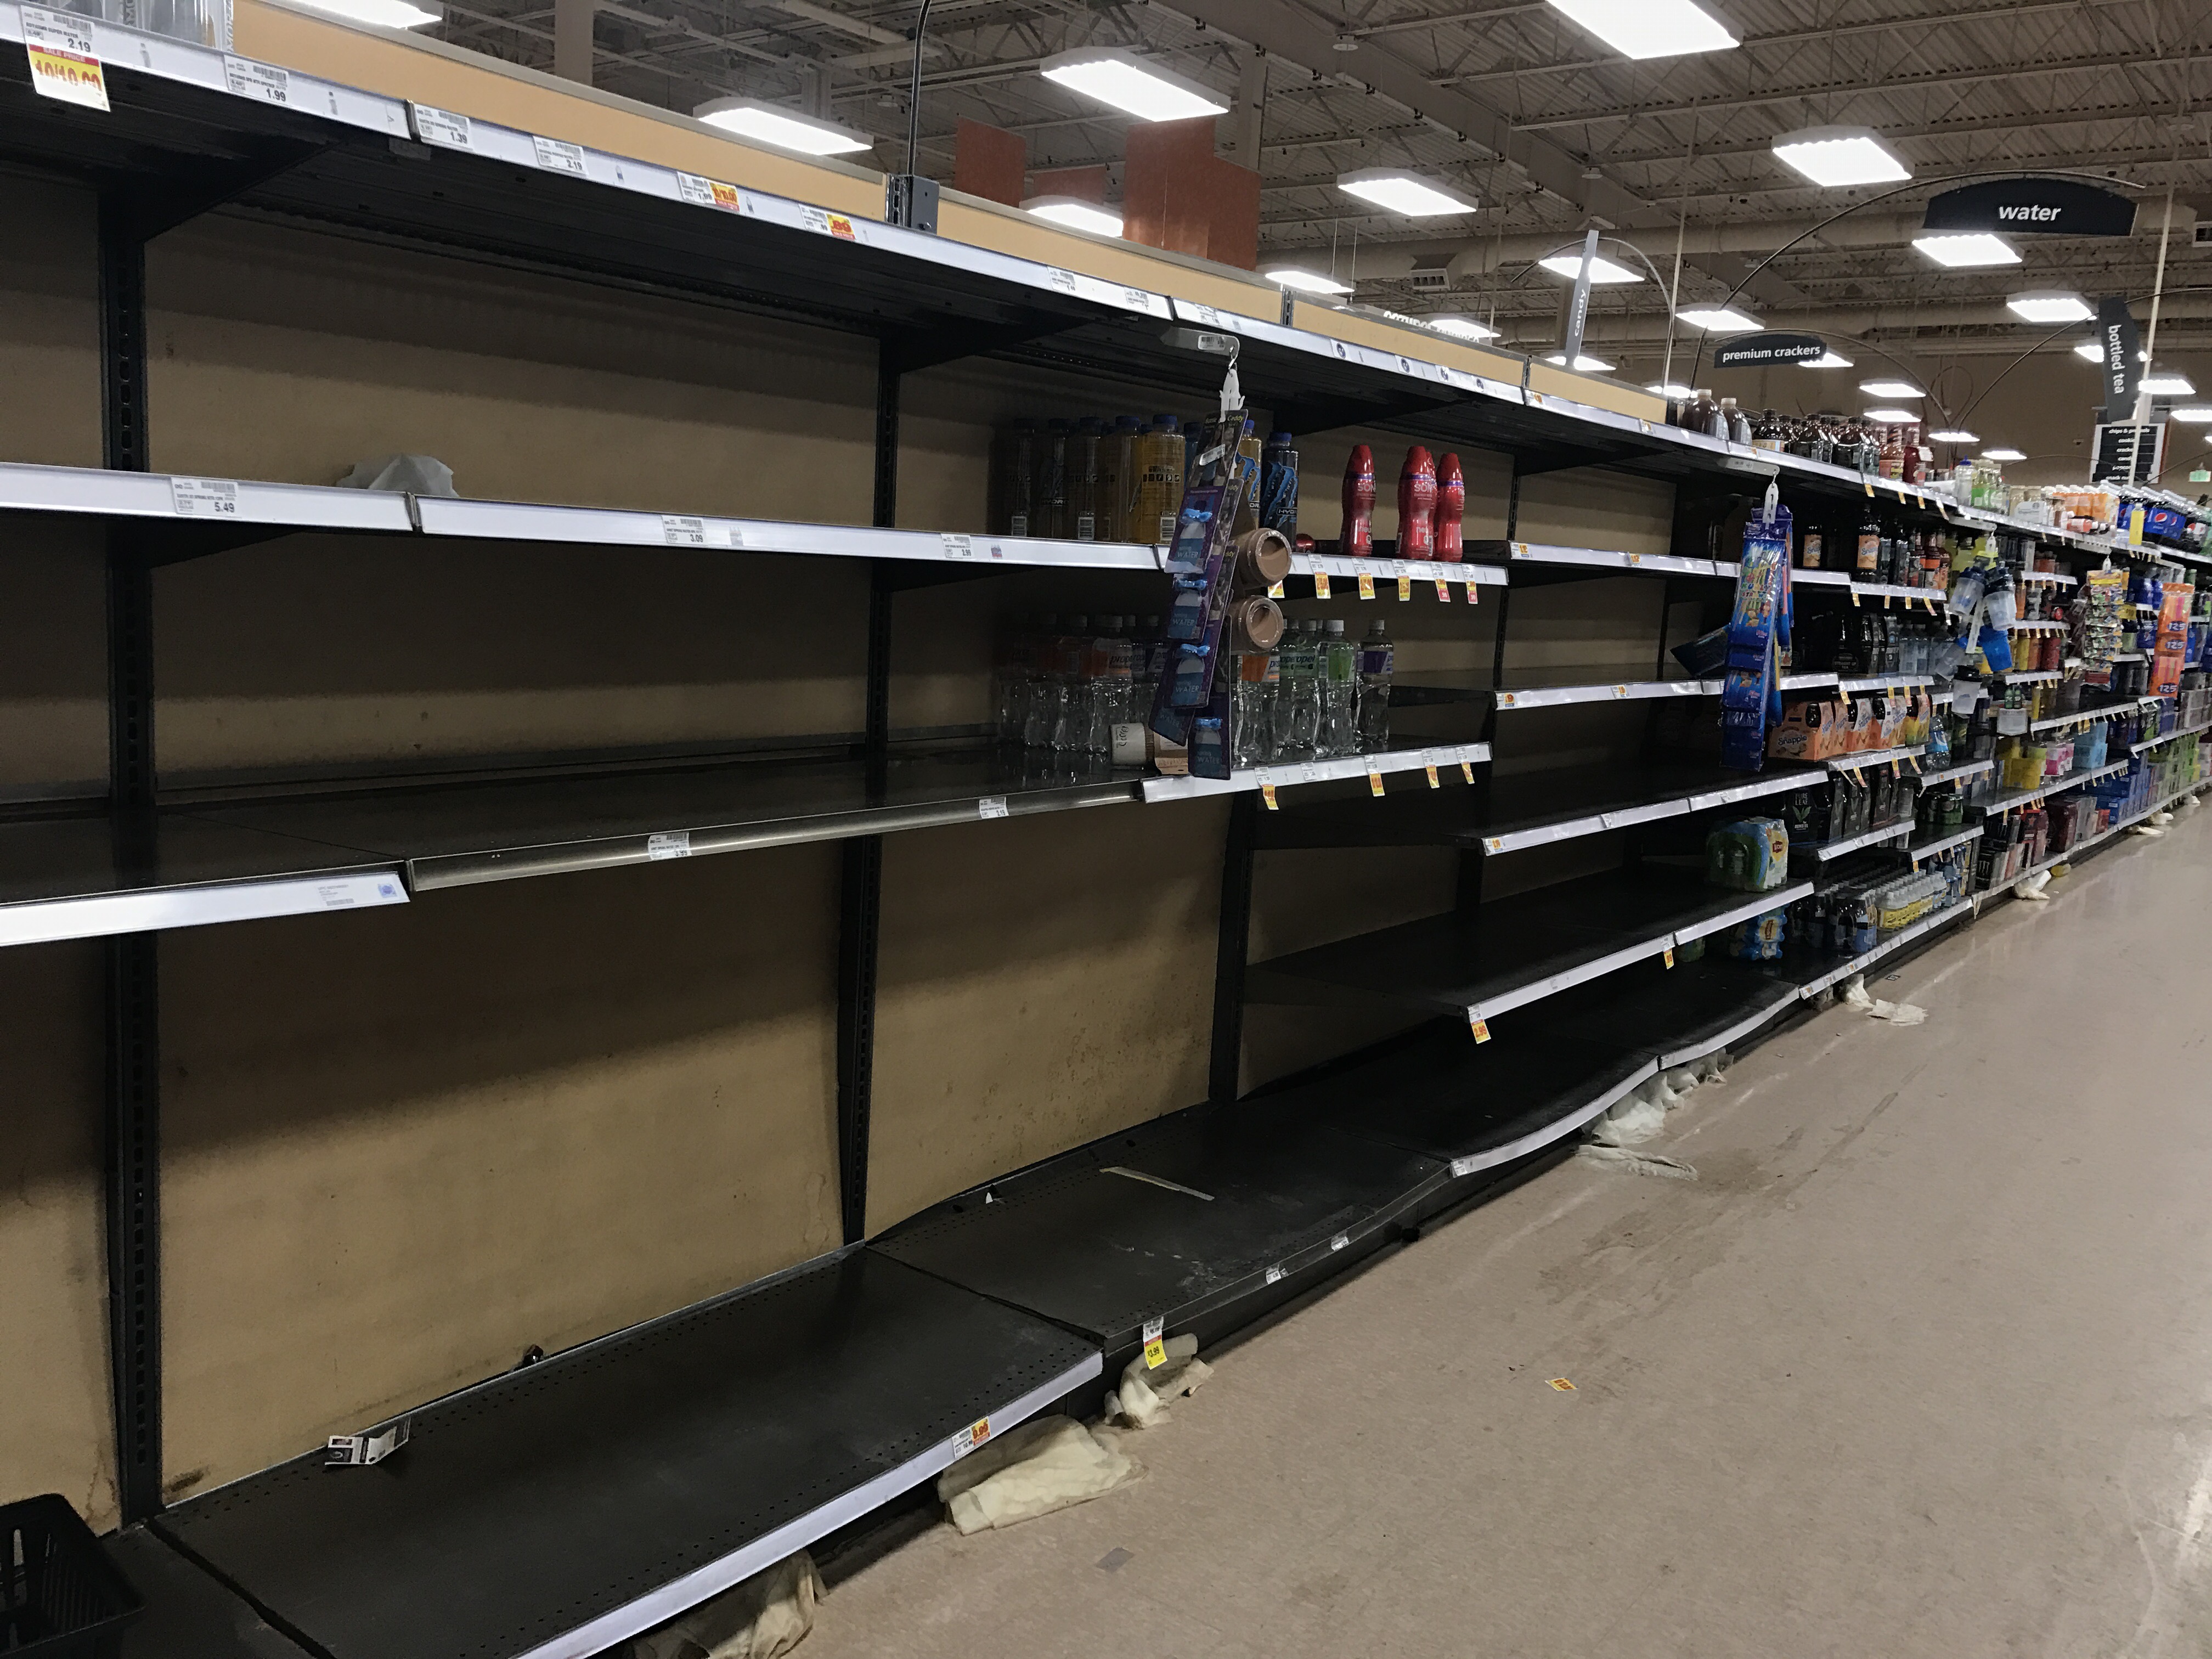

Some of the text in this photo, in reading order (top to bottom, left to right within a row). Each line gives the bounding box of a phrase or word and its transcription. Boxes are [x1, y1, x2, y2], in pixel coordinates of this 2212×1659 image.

[67, 38, 91, 52] 2.19
[266, 88, 286, 103] 1.99
[450, 132, 467, 144] 1.39
[566, 159, 583, 170] 2.19
[1999, 204, 2062, 221] water
[1575, 289, 1586, 337] candy
[1723, 345, 1820, 363] premium crackers
[2108, 324, 2126, 394] bottled tea
[215, 501, 235, 513] 5.49
[690, 534, 703, 543] 3.09
[1778, 734, 1807, 745] Snapple
[1197, 756, 1220, 764] WATER
[1474, 1025, 1487, 1038] 2.99
